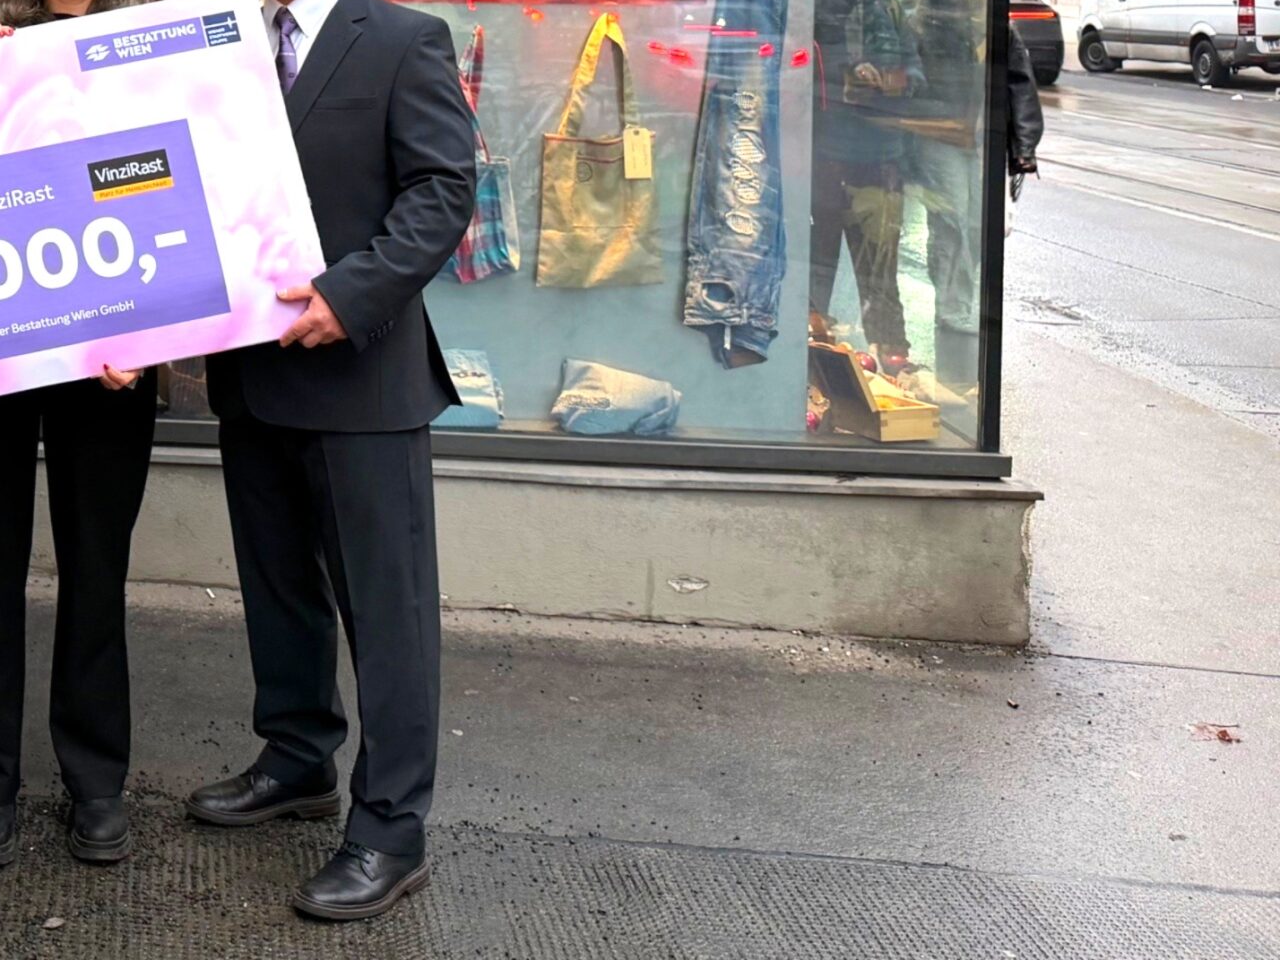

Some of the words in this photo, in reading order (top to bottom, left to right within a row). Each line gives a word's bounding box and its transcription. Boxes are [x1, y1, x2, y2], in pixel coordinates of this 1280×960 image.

[112, 23, 197, 49] BESTATTUNG
[115, 43, 153, 59] WIEN
[94, 157, 165, 183] VinziRast
[11, 313, 71, 334] Bestattung
[69, 308, 99, 322] Wien
[99, 299, 136, 316] GmbH
